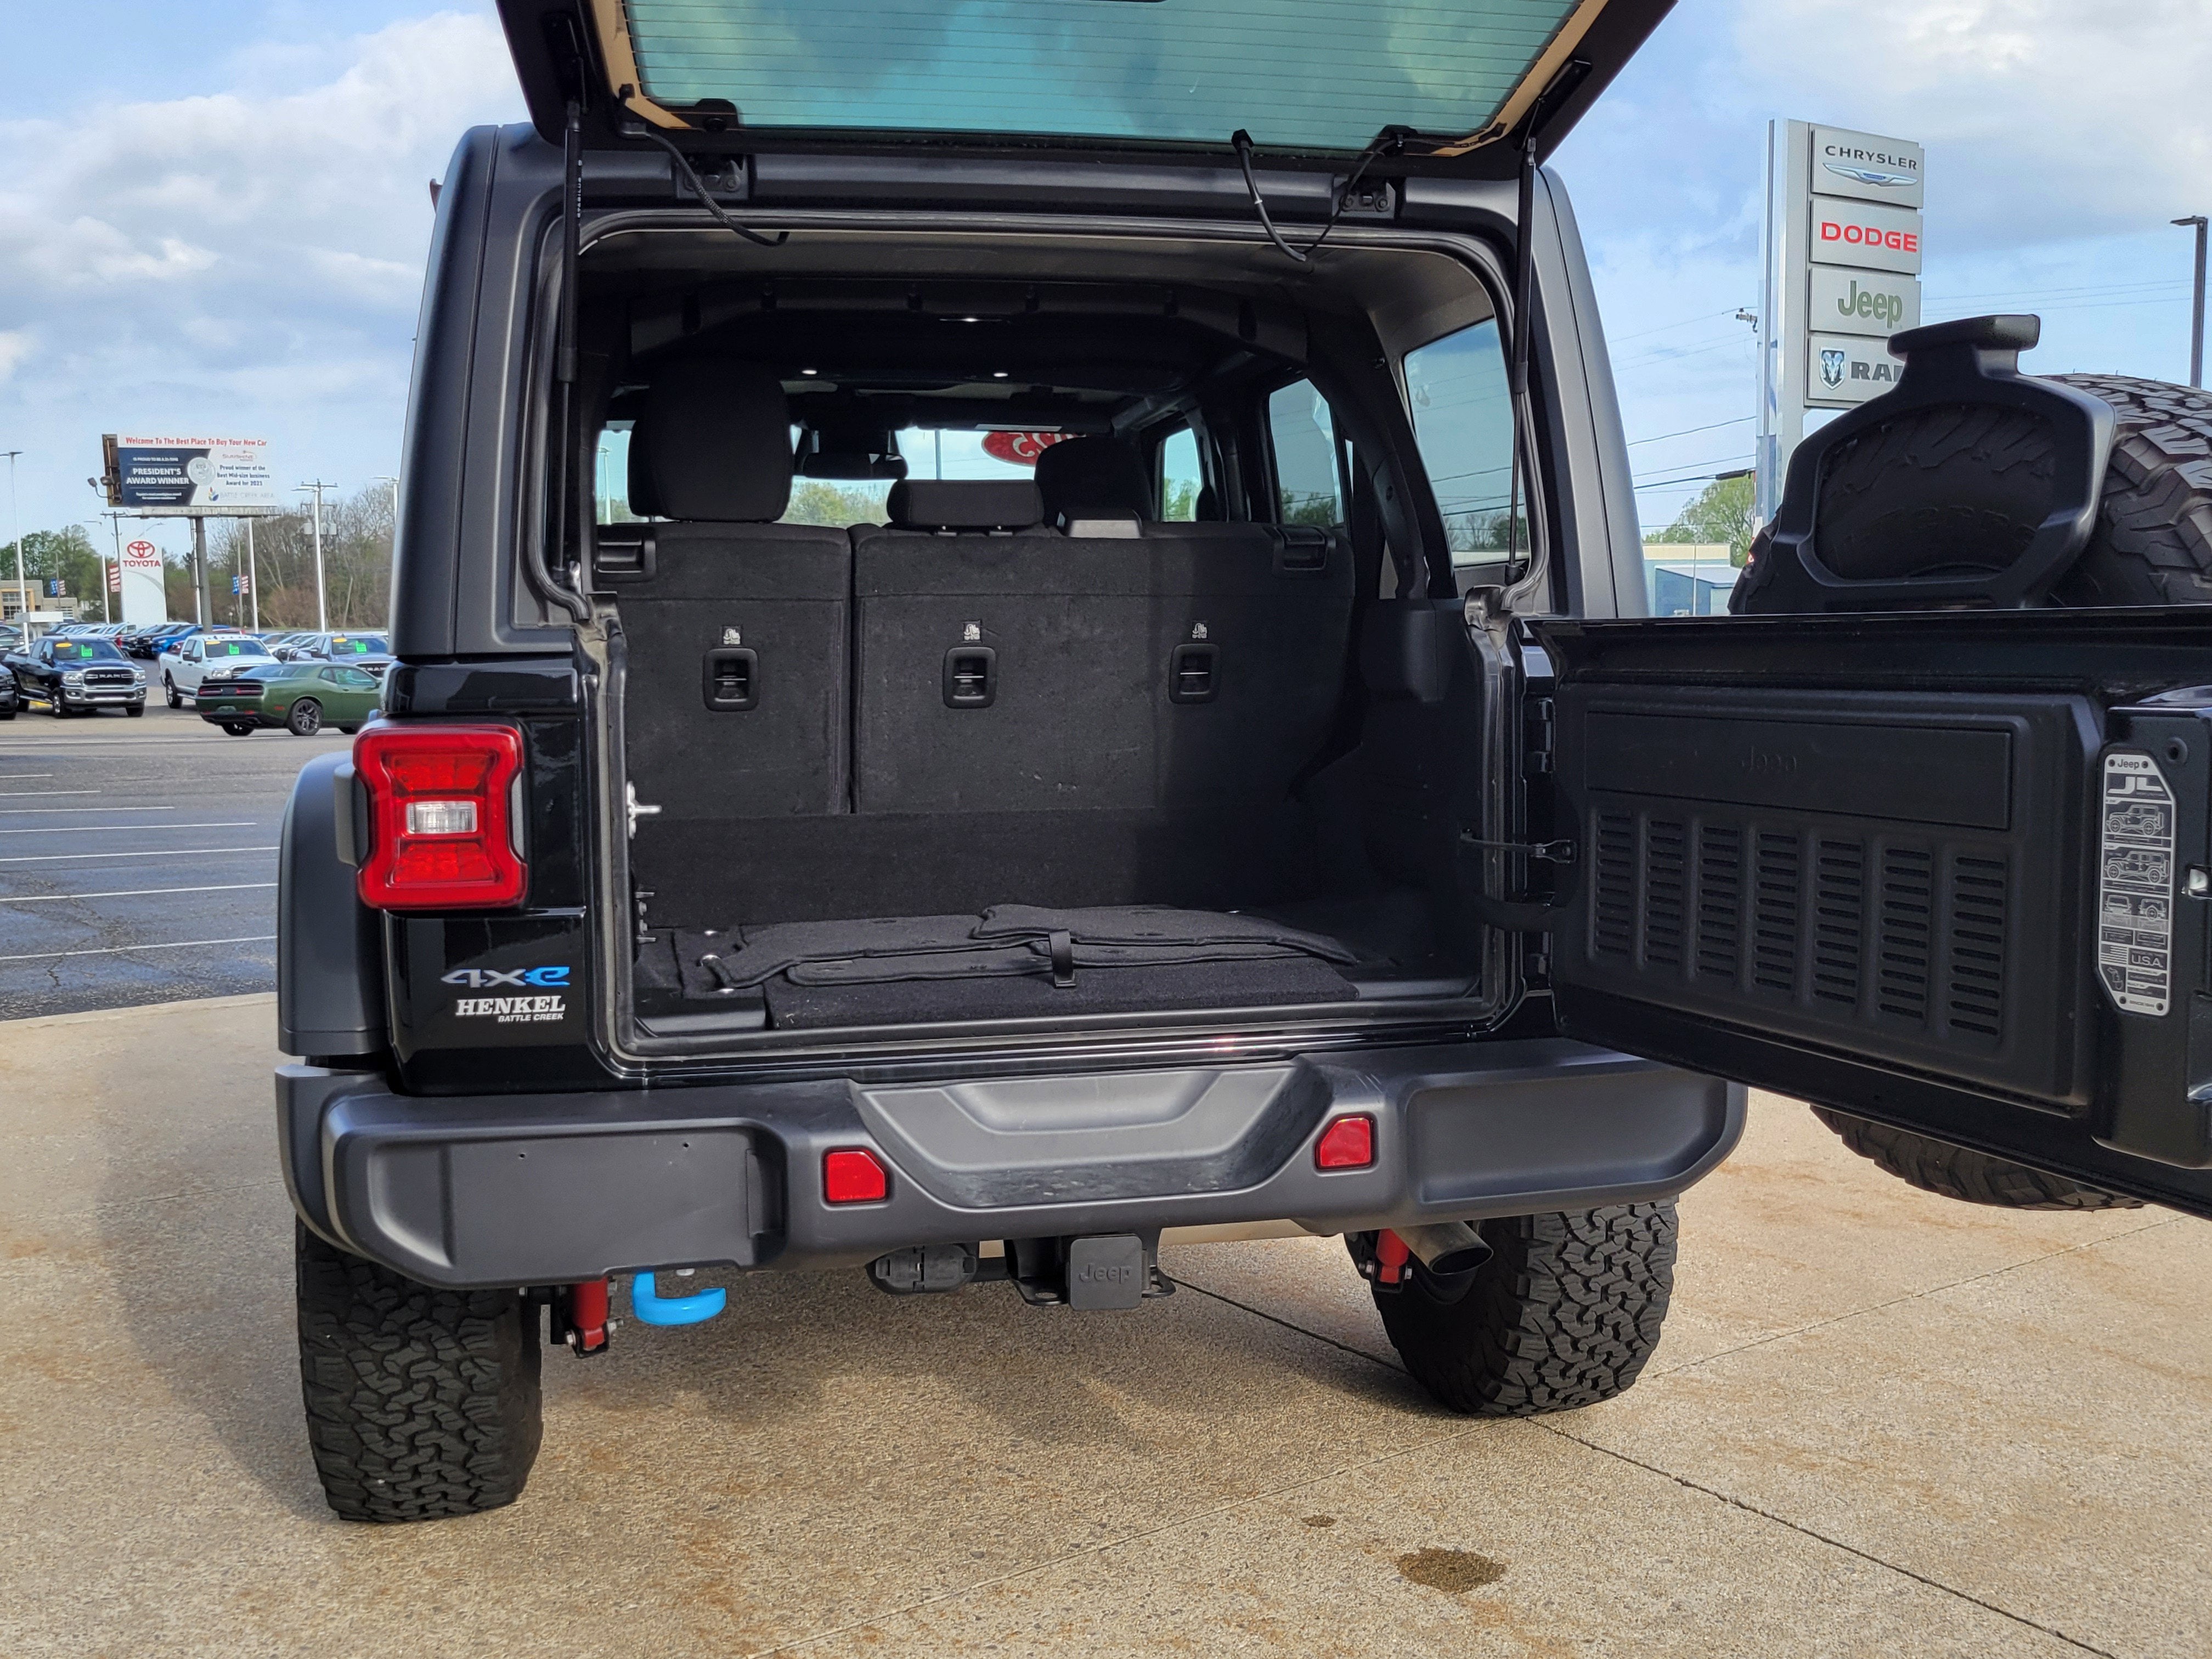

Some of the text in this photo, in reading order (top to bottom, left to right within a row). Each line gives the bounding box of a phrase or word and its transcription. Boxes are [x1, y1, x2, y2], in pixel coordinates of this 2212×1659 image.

[1825, 145, 1917, 170] CHRYSLER
[1821, 222, 1917, 252] DODGE
[1837, 280, 1903, 328] Jeep
[216, 438, 227, 447] Buy
[2117, 759, 2140, 770] Jeep
[455, 995, 566, 1016] HENKEL
[498, 1013, 564, 1023] BATTLE CREEK
[1078, 1263, 1131, 1284] Jeep
